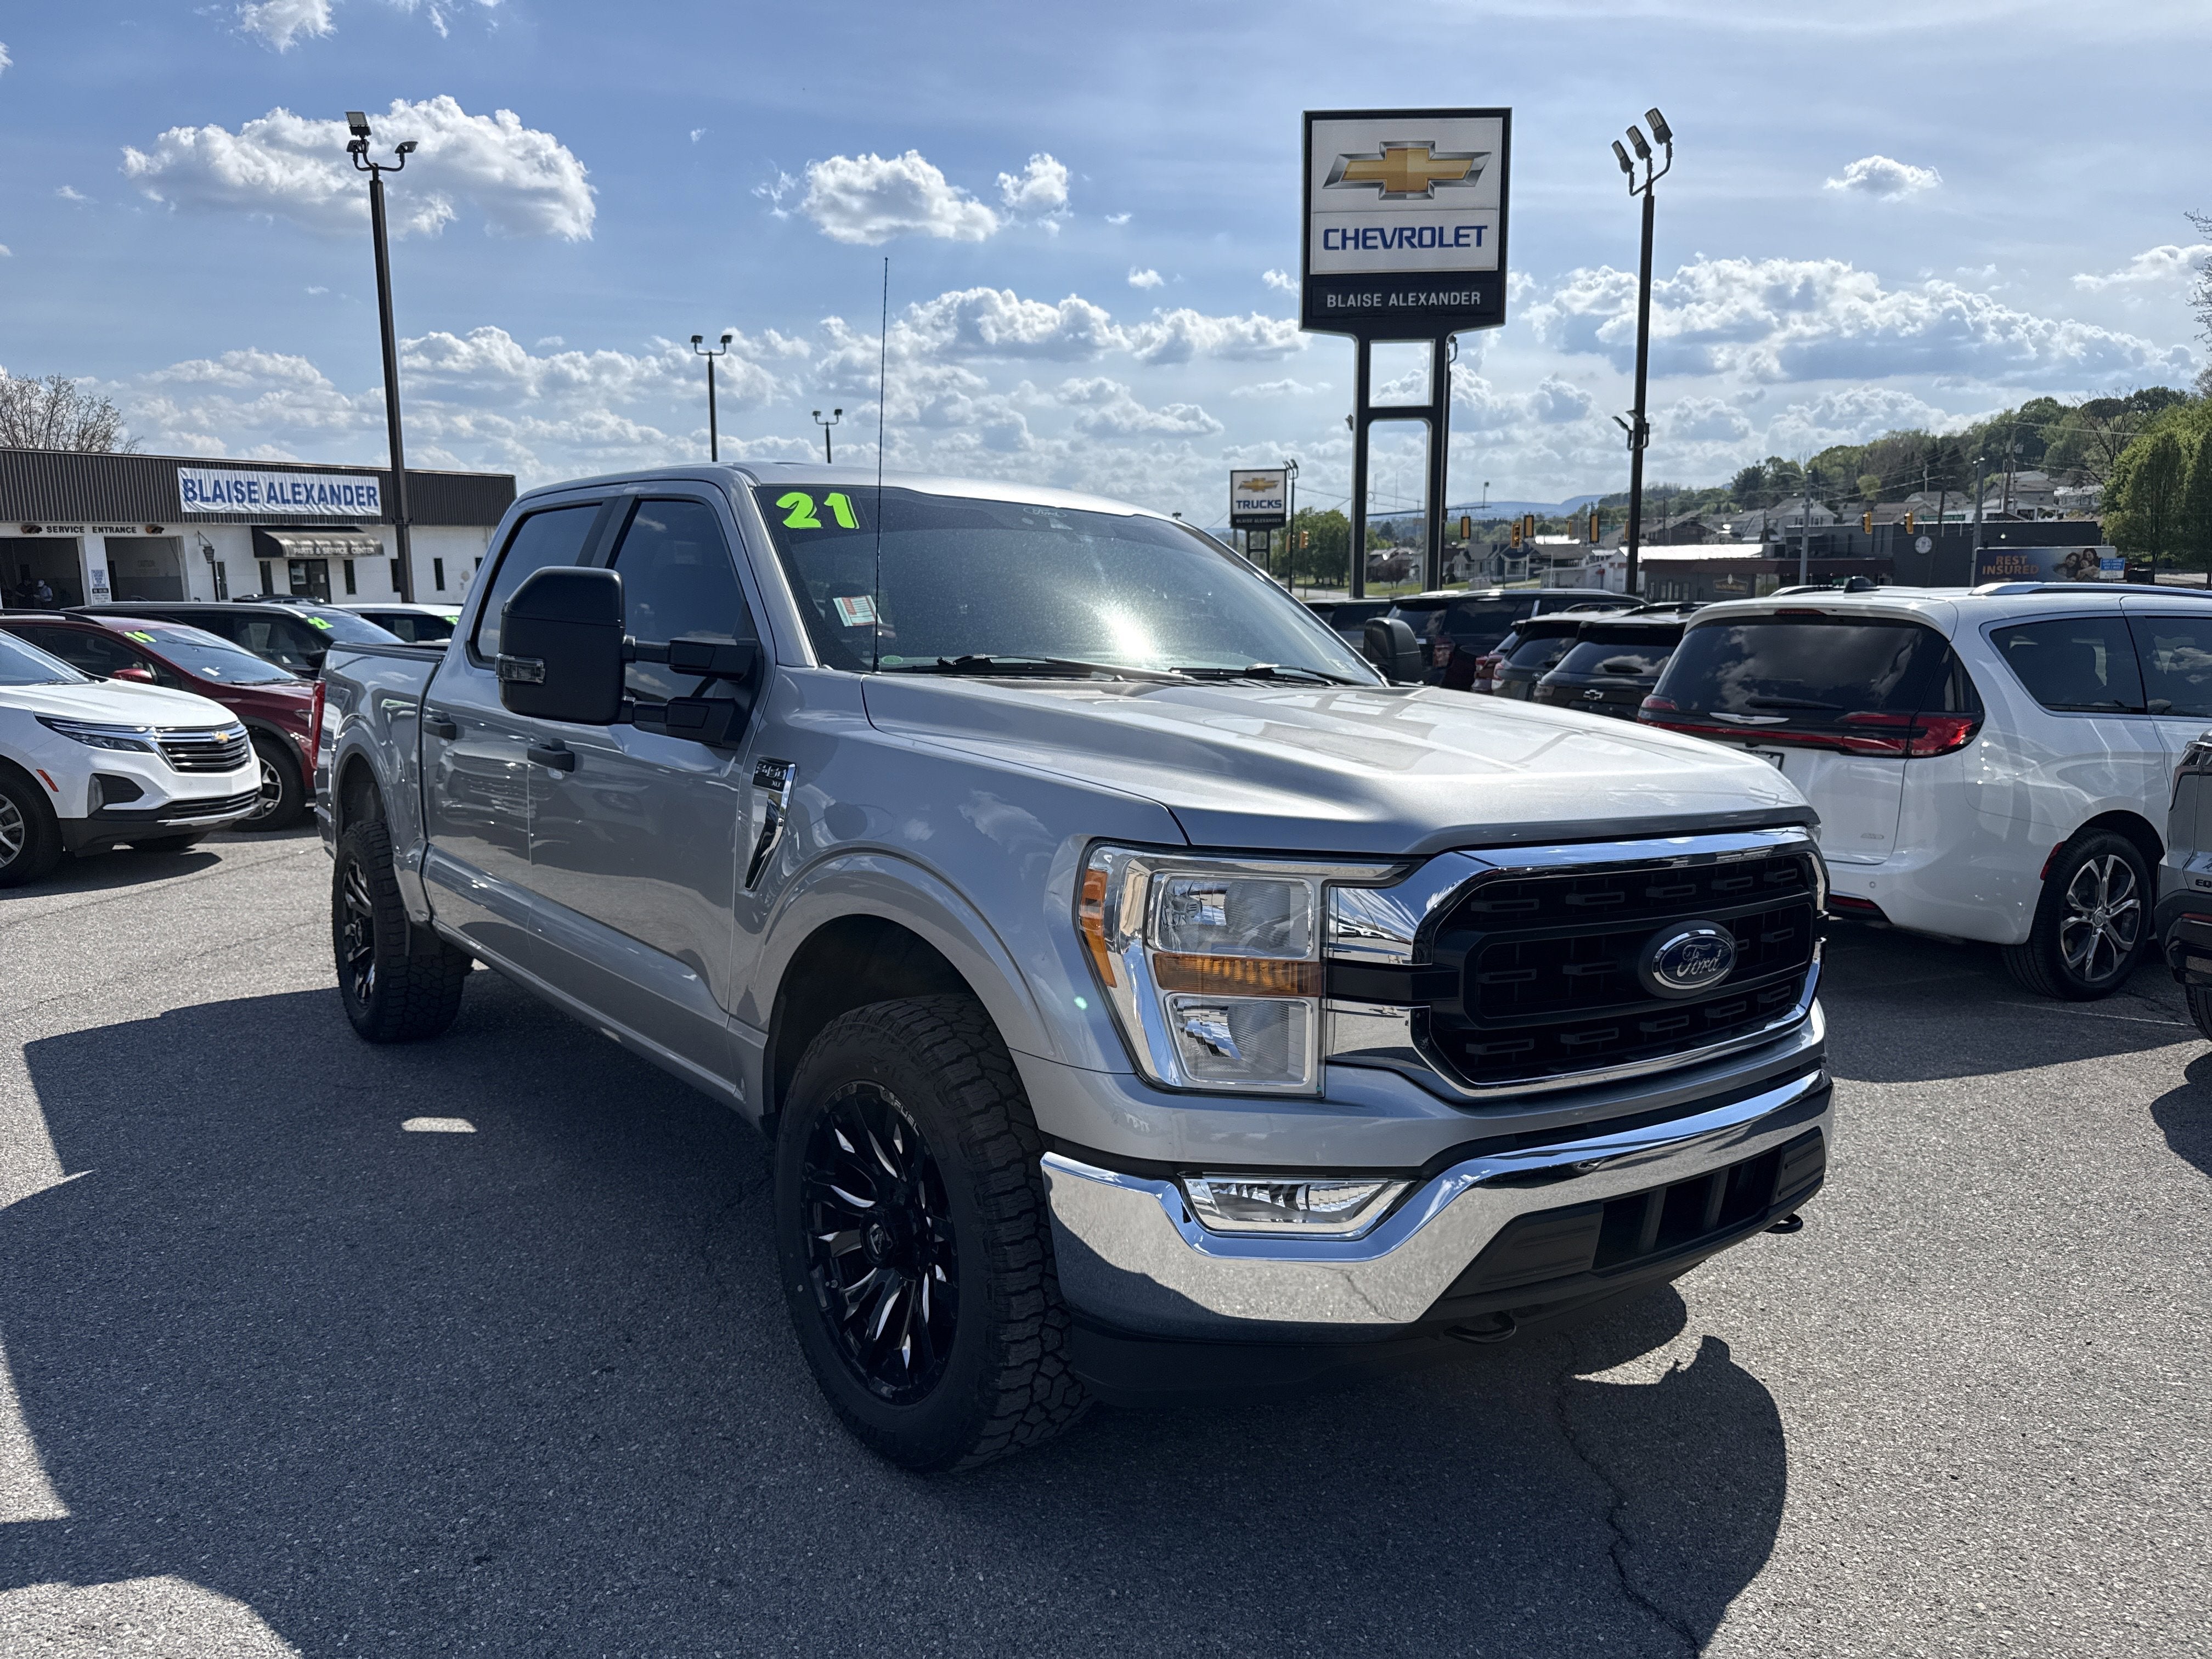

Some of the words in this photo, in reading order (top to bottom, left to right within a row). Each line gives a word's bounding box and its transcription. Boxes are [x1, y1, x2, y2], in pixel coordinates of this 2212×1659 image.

[1323, 225, 1487, 250] CHEVROLET
[1327, 294, 1382, 308] BLAISE
[1388, 292, 1481, 307] ALEXANDER
[183, 478, 260, 504] BLAISE
[267, 482, 379, 506] ALEXANDER
[776, 492, 859, 529] 21
[1235, 499, 1282, 509] TRUCKS
[1031, 508, 1060, 517] Ford
[1996, 555, 2027, 565] REST
[1982, 565, 2039, 575] INSURED
[2196, 879, 2212, 888] EQ
[1677, 944, 1722, 977] Ford
[894, 1099, 919, 1137] FUEL
